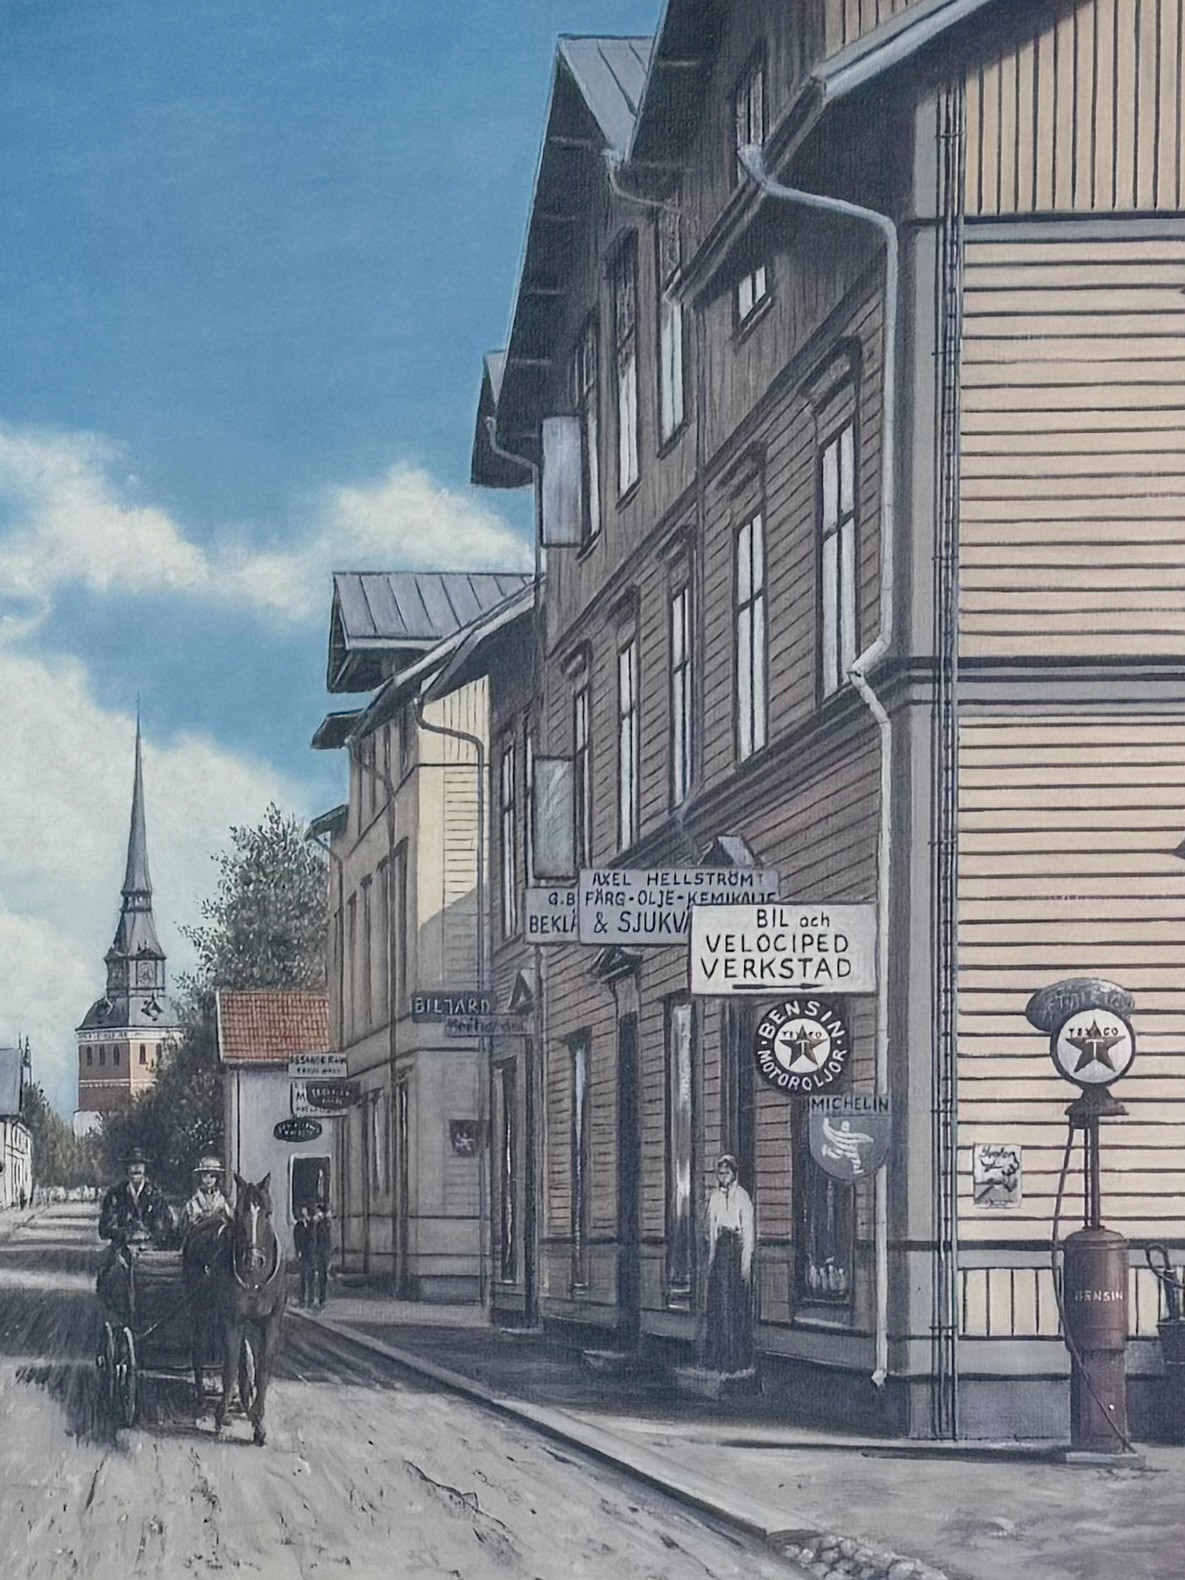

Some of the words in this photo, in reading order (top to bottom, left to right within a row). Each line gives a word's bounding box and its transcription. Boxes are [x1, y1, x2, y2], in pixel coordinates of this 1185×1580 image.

[592, 872, 632, 886] AXEL
[647, 870, 753, 887] HELLSTRÖM
[594, 911, 608, 934] &
[756, 908, 789, 928] BIL
[799, 911, 830, 928] och
[706, 933, 849, 953] VELOCIPED
[700, 957, 852, 980] VERKSTAD
[758, 1000, 845, 1039] BENSIN
[757, 1049, 848, 1091] MOTOROLJOR
[811, 1096, 889, 1112] MICHELIN
[1074, 1289, 1124, 1302] BENSIN
